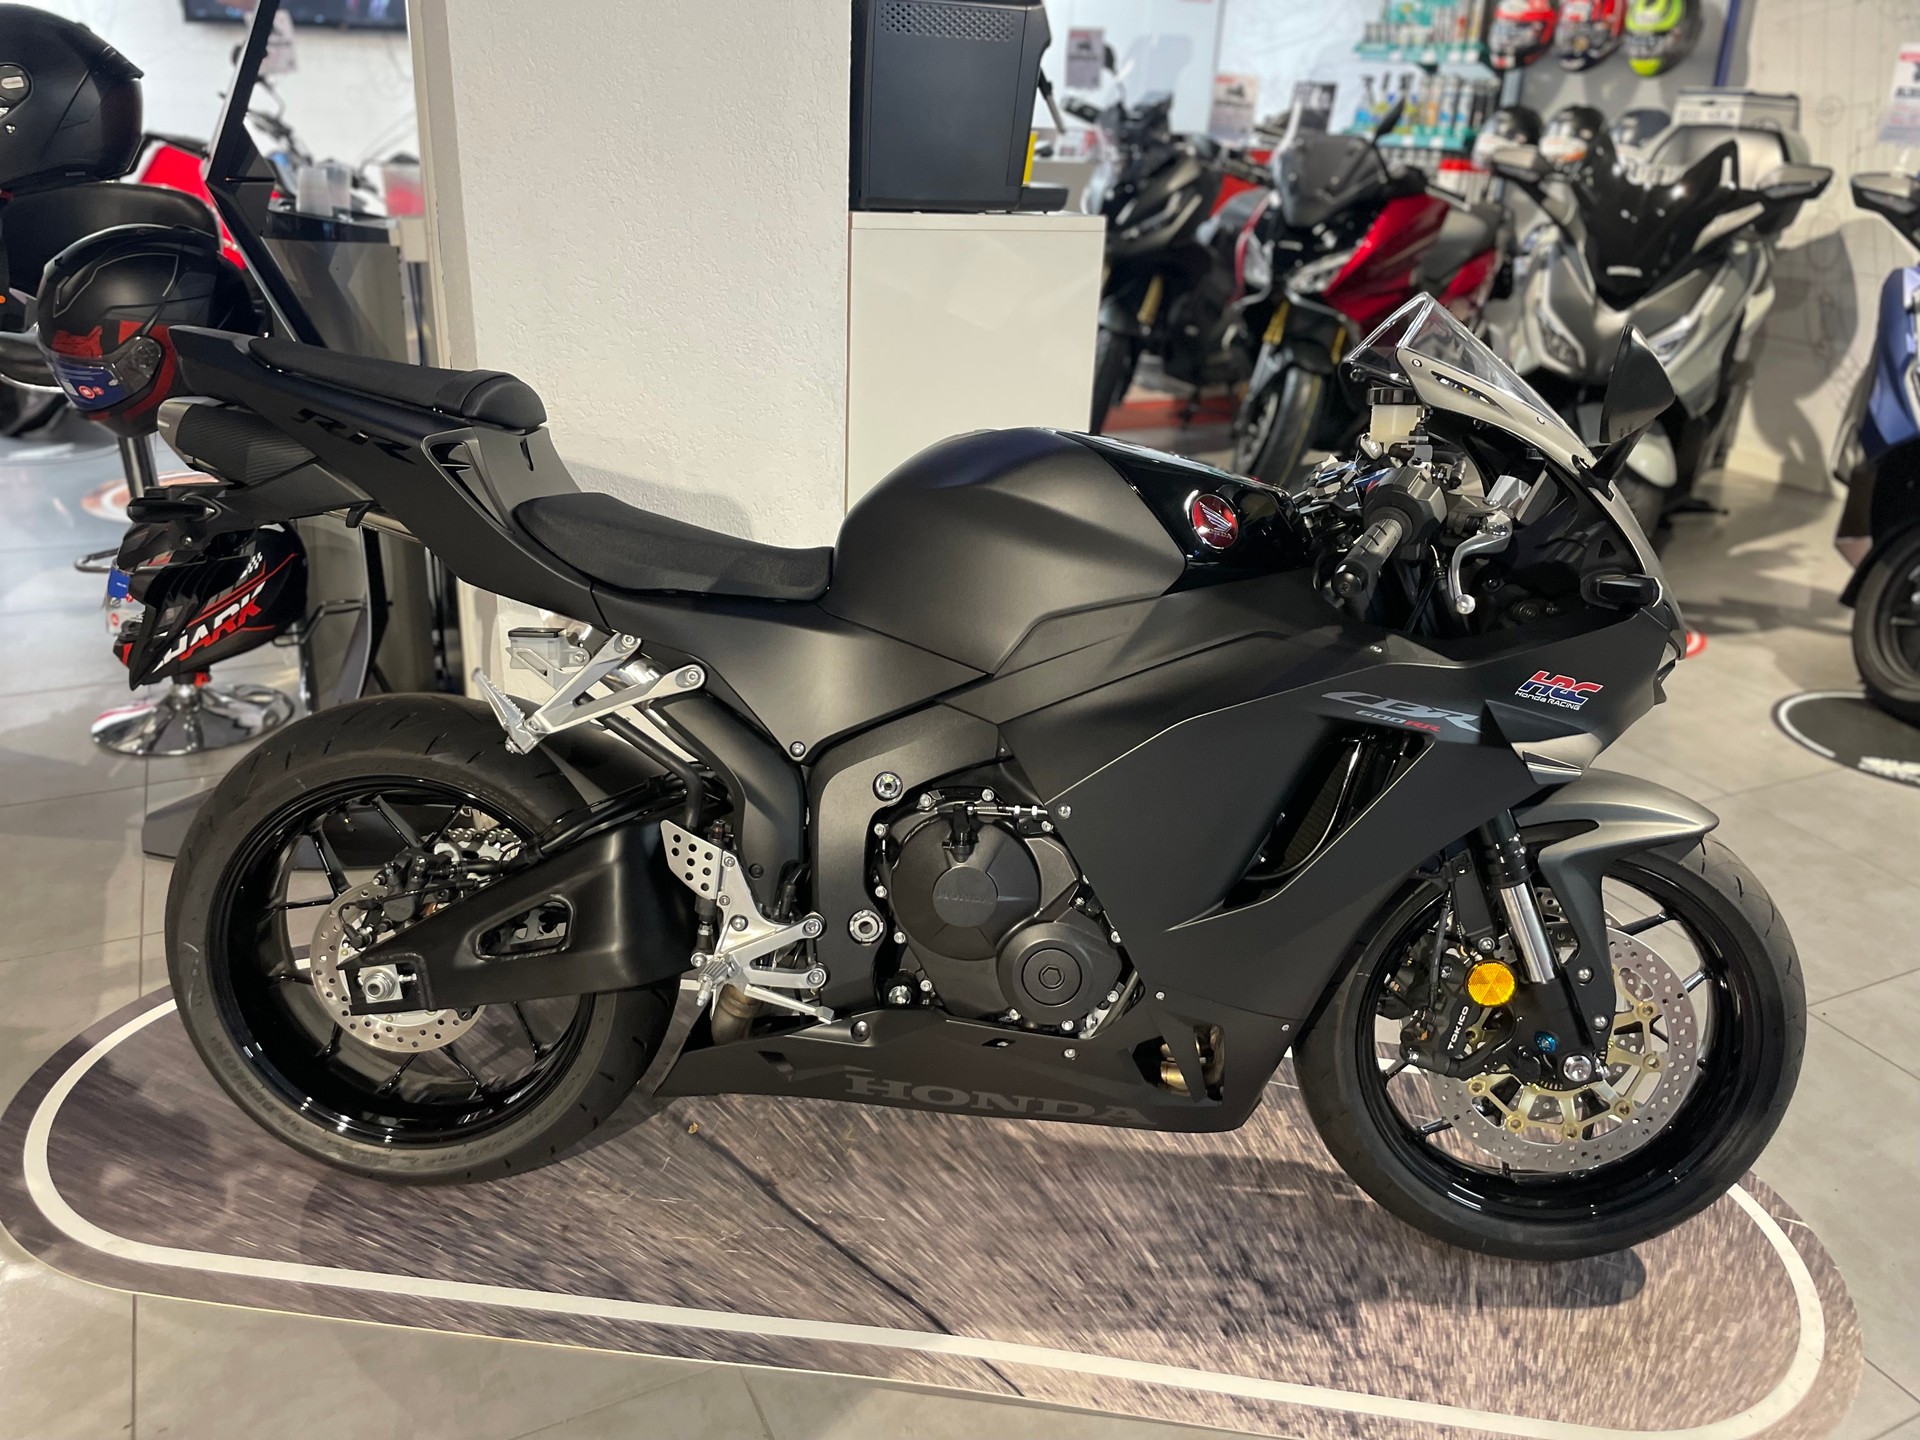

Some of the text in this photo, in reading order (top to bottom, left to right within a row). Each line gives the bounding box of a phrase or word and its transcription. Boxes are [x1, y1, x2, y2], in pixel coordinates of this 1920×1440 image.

[1517, 669, 1604, 706] HRC
[1547, 699, 1581, 711] RACING
[1321, 691, 1484, 733] CBR
[1355, 709, 1441, 733] 600RR
[1446, 1005, 1470, 1051] TOKICO
[845, 1073, 1157, 1126] HONDA
